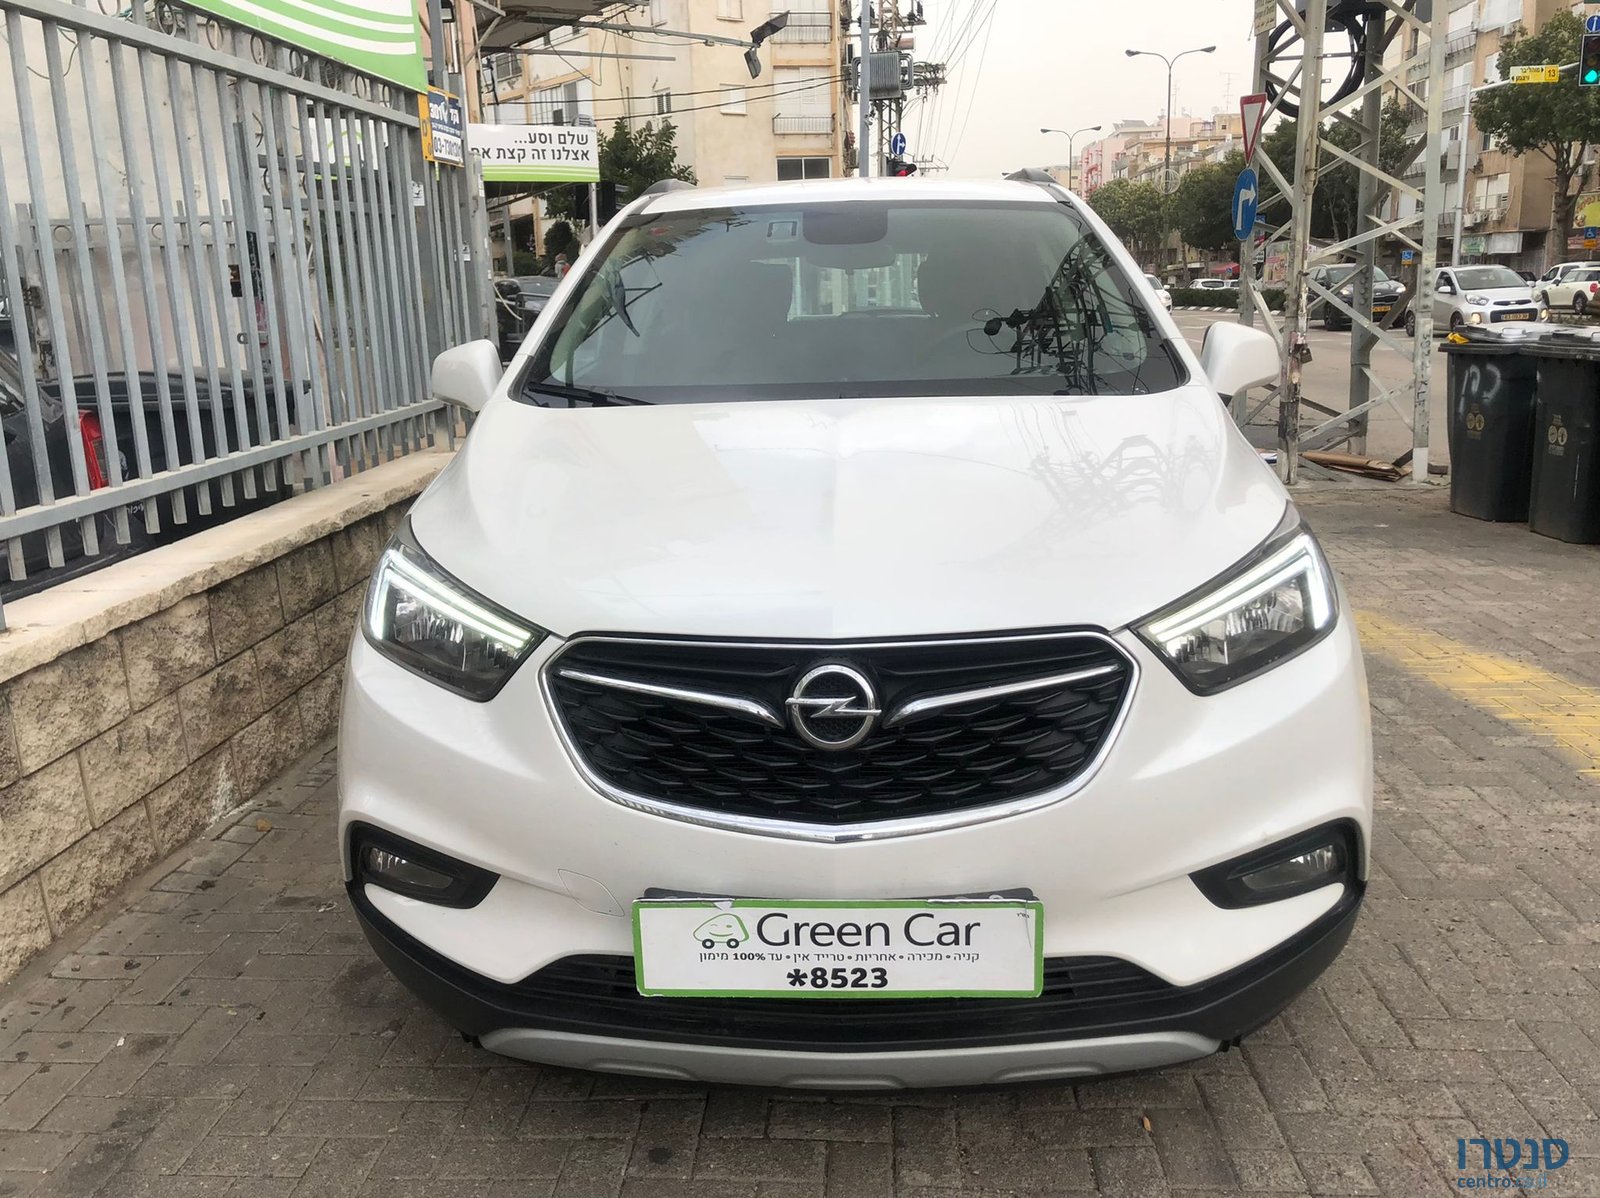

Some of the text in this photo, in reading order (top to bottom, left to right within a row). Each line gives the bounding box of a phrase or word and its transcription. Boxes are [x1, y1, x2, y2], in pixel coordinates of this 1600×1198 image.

[1548, 69, 1556, 77] 13
[514, 131, 589, 145] שלם וסע...
[496, 147, 527, 163] קצת
[532, 148, 547, 160] זה
[551, 146, 590, 161] אצלנו
[756, 912, 981, 947] Green Car
[699, 952, 980, 963] קניה מכירה אחריות טרייד אין עד 100% מימון
